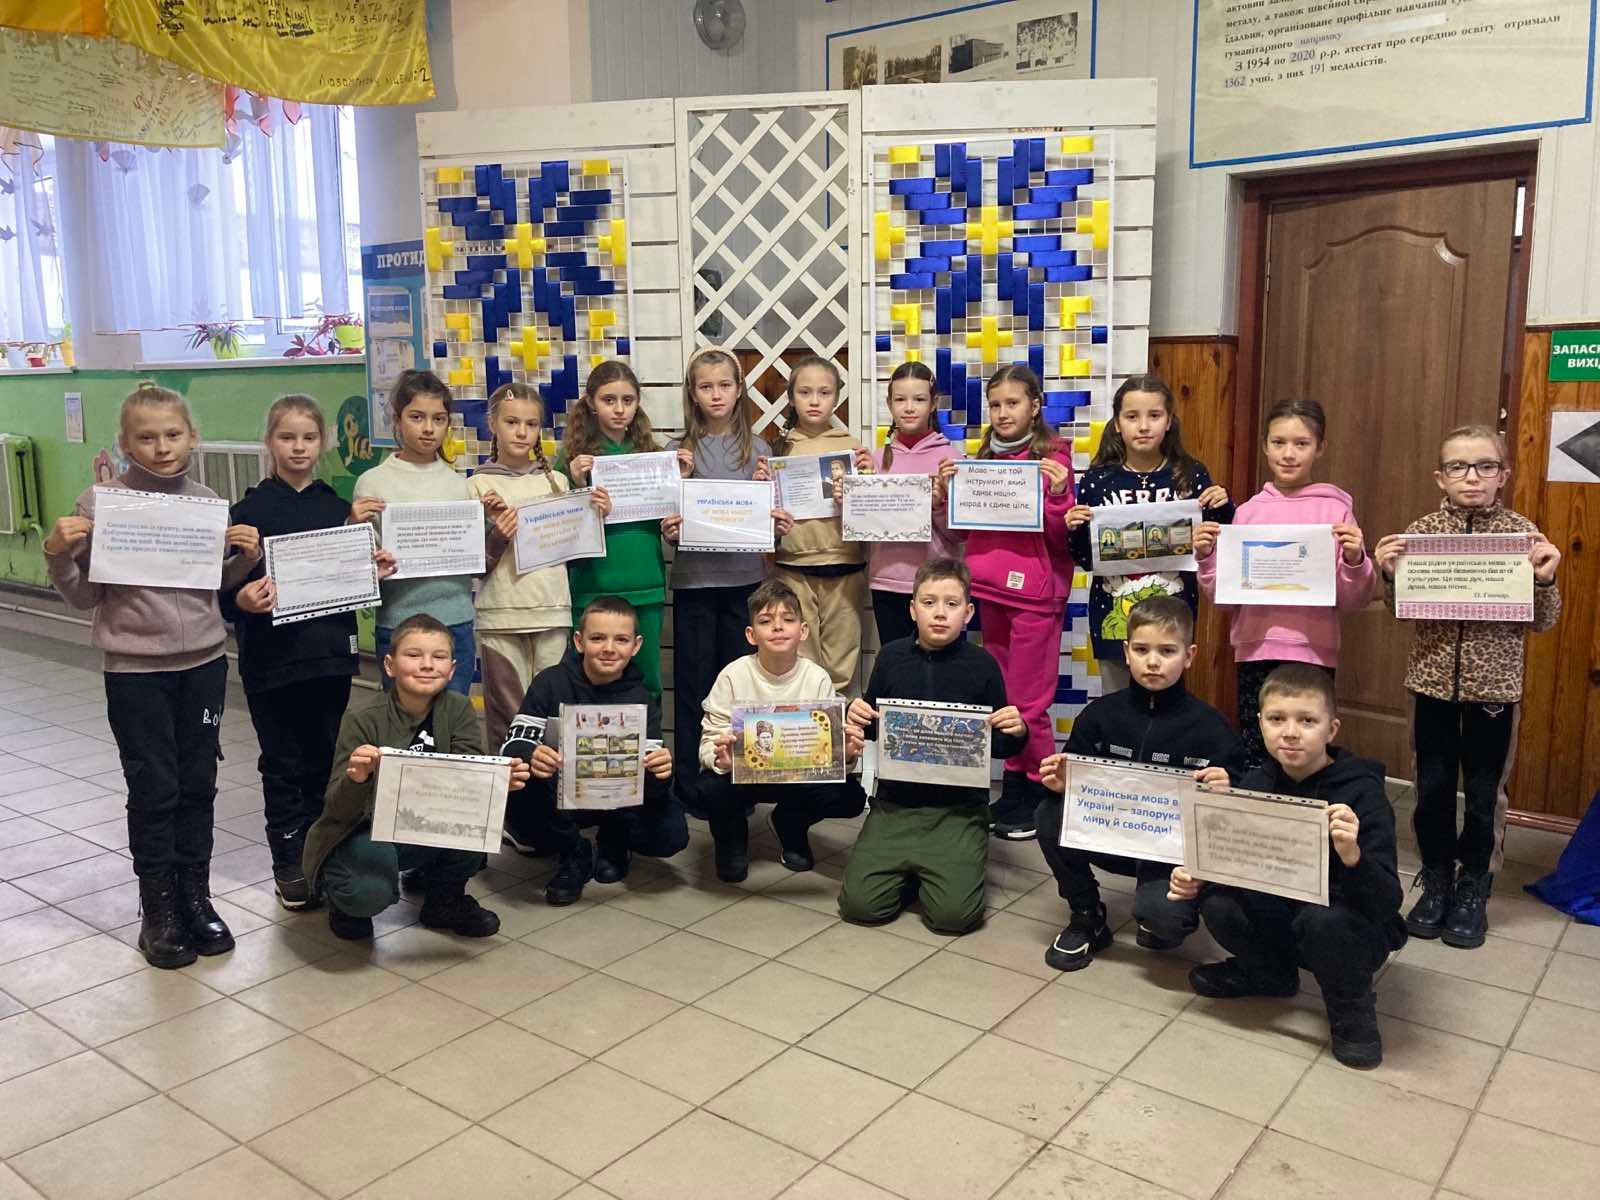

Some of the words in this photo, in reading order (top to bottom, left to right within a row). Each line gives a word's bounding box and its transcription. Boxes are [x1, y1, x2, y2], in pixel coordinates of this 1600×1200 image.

[1226, 16, 1261, 28] металу,
[1274, 8, 1304, 19] також
[1268, 19, 1333, 36] організоване
[1336, 8, 1392, 25] профільне
[1225, 41, 1293, 59] гуманітарного
[1247, 57, 1270, 70] 1954
[1290, 50, 1315, 63] 2020
[1344, 43, 1381, 54] атестат
[1386, 38, 1406, 49] про
[1410, 29, 1457, 45] середню
[1461, 23, 1496, 35] освіту
[1504, 15, 1561, 30] отримали
[1224, 76, 1246, 89] 1362
[1249, 73, 1274, 87] учні,
[1286, 70, 1304, 79] них
[1310, 63, 1326, 74] 191
[1330, 57, 1387, 71] медалістів.
[1567, 358, 1600, 369] ВИХІ
[1080, 784, 1139, 801] Українська
[1141, 795, 1169, 806] мова
[1172, 799, 1179, 807] в
[1077, 798, 1114, 812] Україні
[1131, 807, 1180, 820] запорука
[1083, 815, 1111, 827] миру
[1113, 817, 1120, 826] й
[1122, 820, 1172, 834] свободи!
